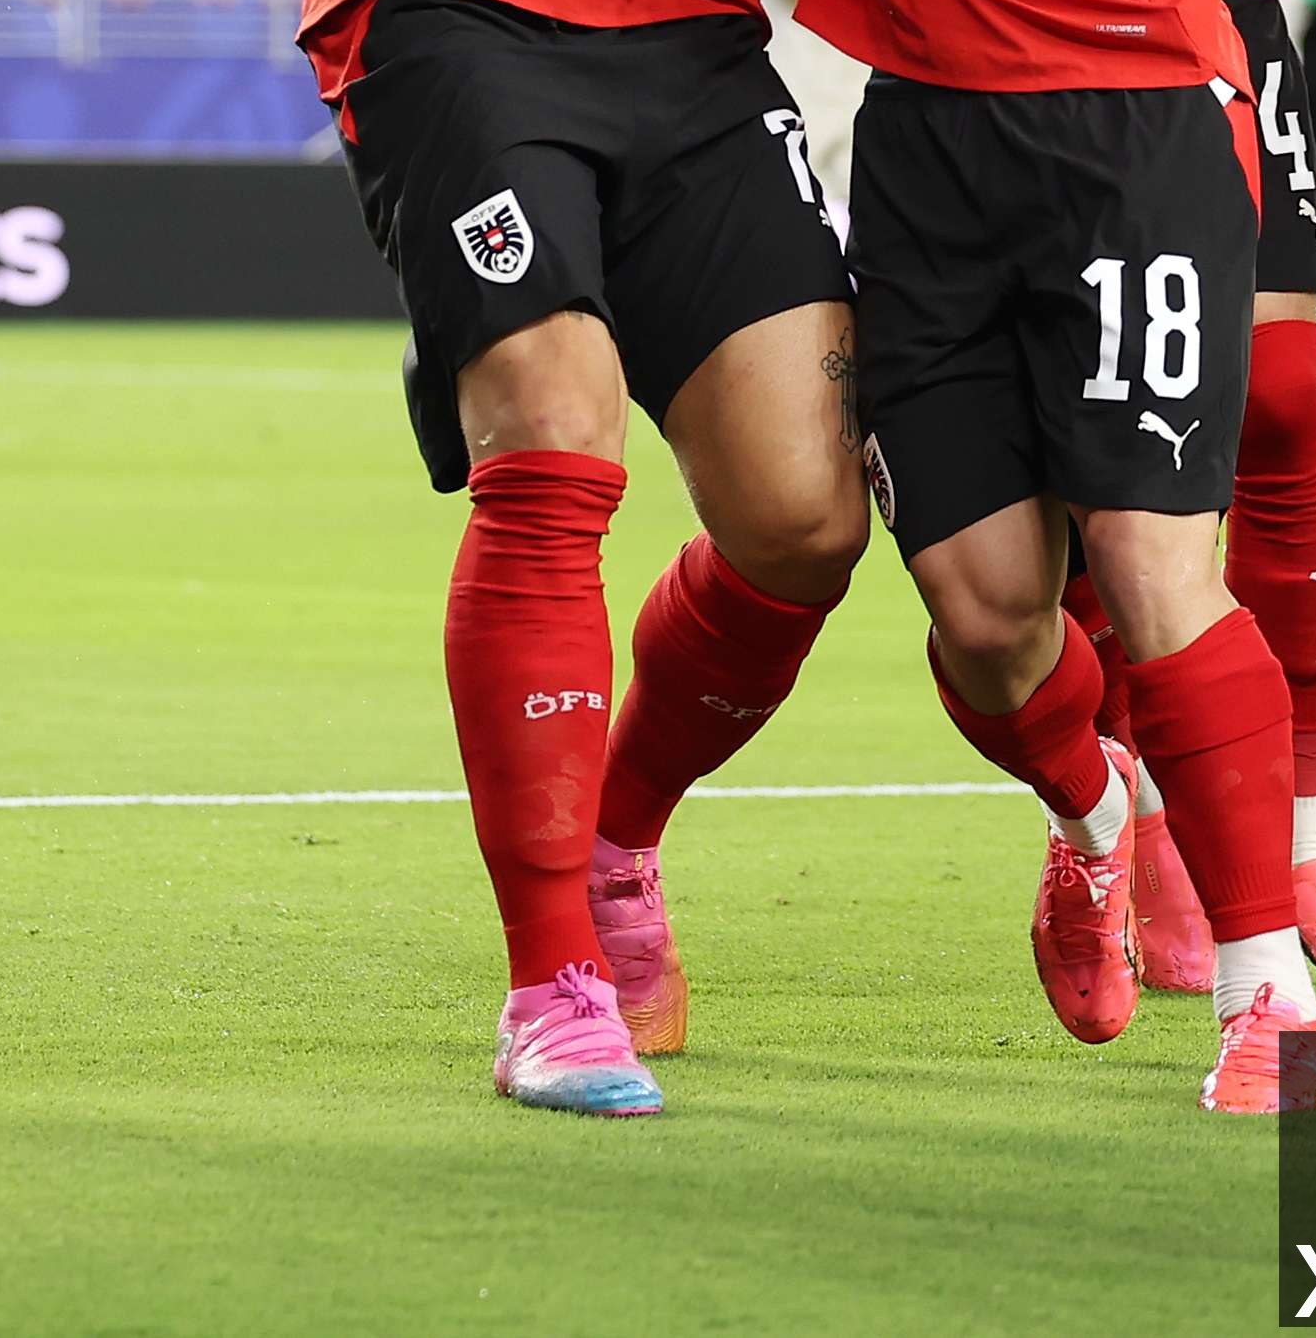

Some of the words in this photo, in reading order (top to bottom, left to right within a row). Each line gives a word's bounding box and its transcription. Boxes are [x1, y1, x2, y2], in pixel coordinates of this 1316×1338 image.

[1258, 61, 1316, 191] 4
[1081, 254, 1200, 401] 18
[524, 690, 607, 720] ÖFB
